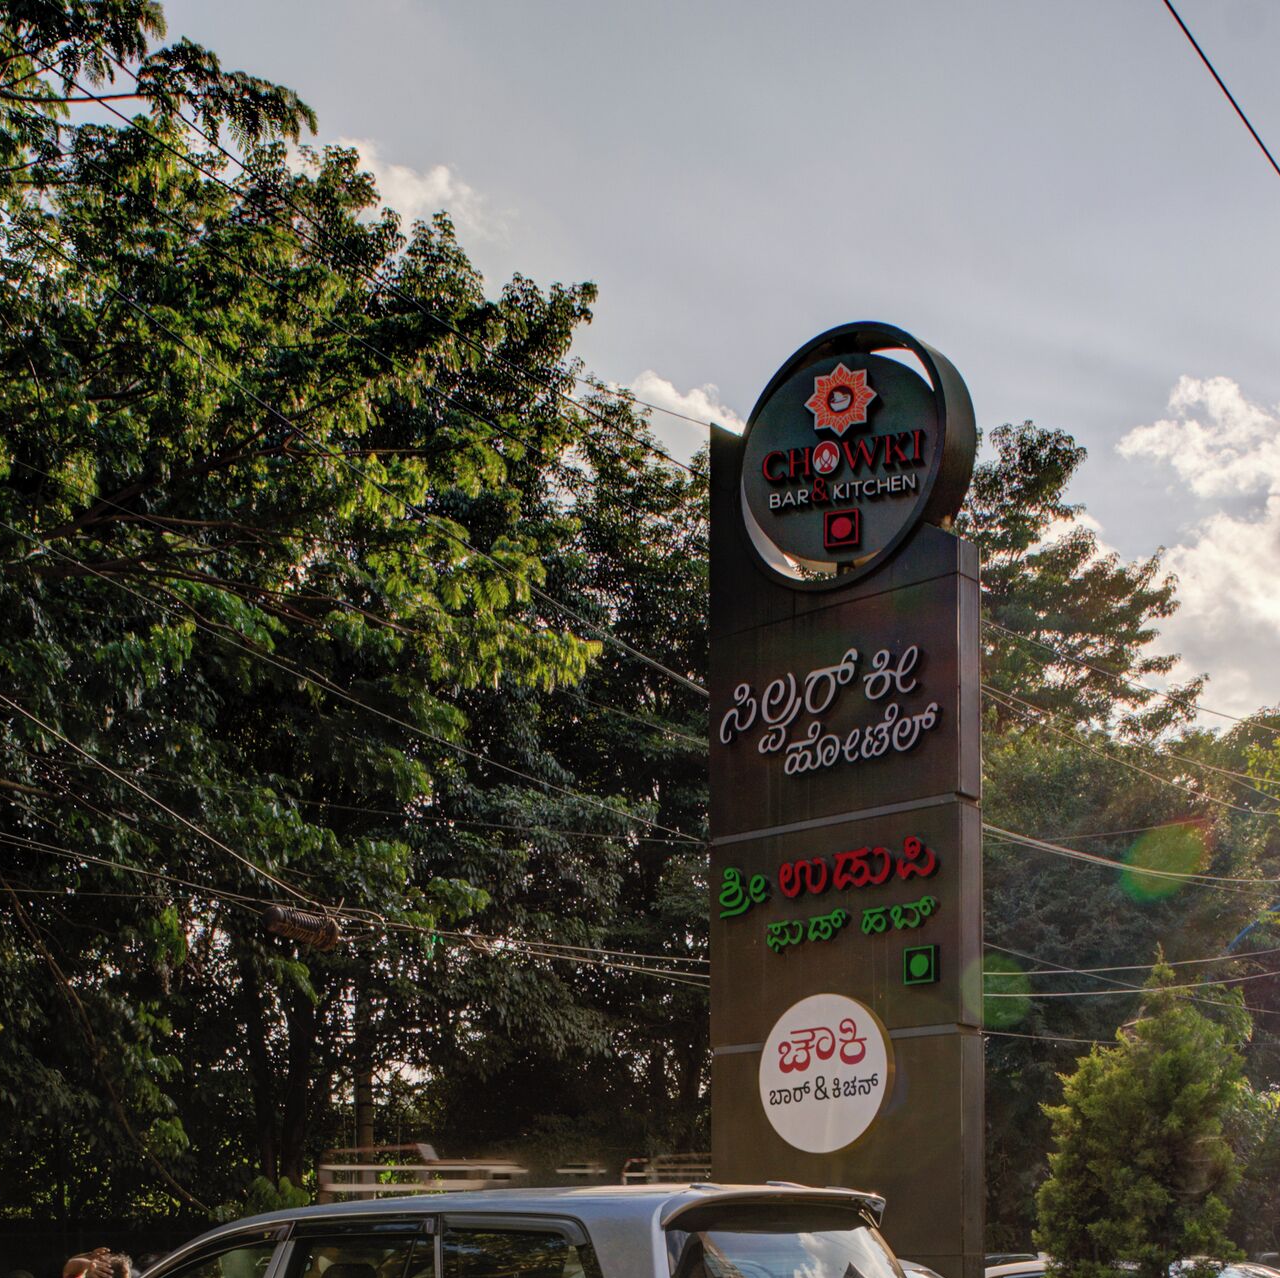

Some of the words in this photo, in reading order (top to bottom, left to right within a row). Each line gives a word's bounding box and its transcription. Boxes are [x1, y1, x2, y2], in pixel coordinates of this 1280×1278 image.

[762, 430, 922, 482] CHOWKI
[768, 488, 809, 510] BAR
[811, 478, 830, 503] &
[832, 473, 917, 500] KITCHEN
[719, 647, 859, 754] ಸಿಲ್ವರ್
[718, 866, 767, 919] ಶ್ರೀ
[778, 835, 936, 898] ಉಡುಪಿ
[860, 895, 935, 935] ಹಬ್
[777, 1017, 868, 1074] ಚೌಕಿ
[768, 1080, 811, 1106] ಬಾರ್
[814, 1075, 830, 1101] &
[831, 1072, 879, 1099] ಕಿಚನ್
